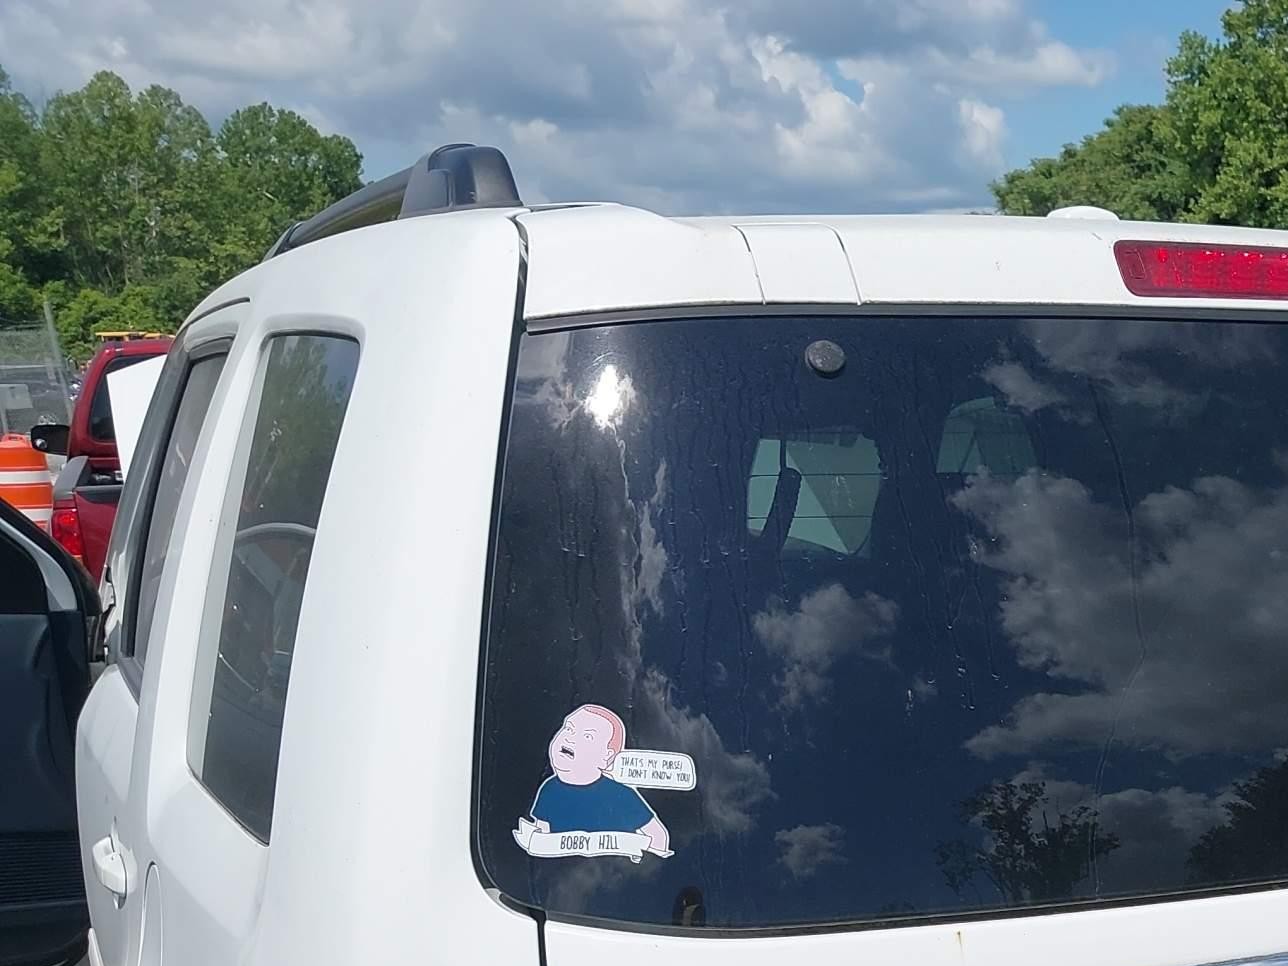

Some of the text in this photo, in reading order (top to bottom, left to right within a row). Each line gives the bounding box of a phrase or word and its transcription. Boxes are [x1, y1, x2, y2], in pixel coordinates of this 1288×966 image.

[648, 759, 658, 769] MY
[620, 767, 624, 777] I
[652, 770, 672, 780] KNOW
[560, 835, 619, 850] BOBBY HILL
